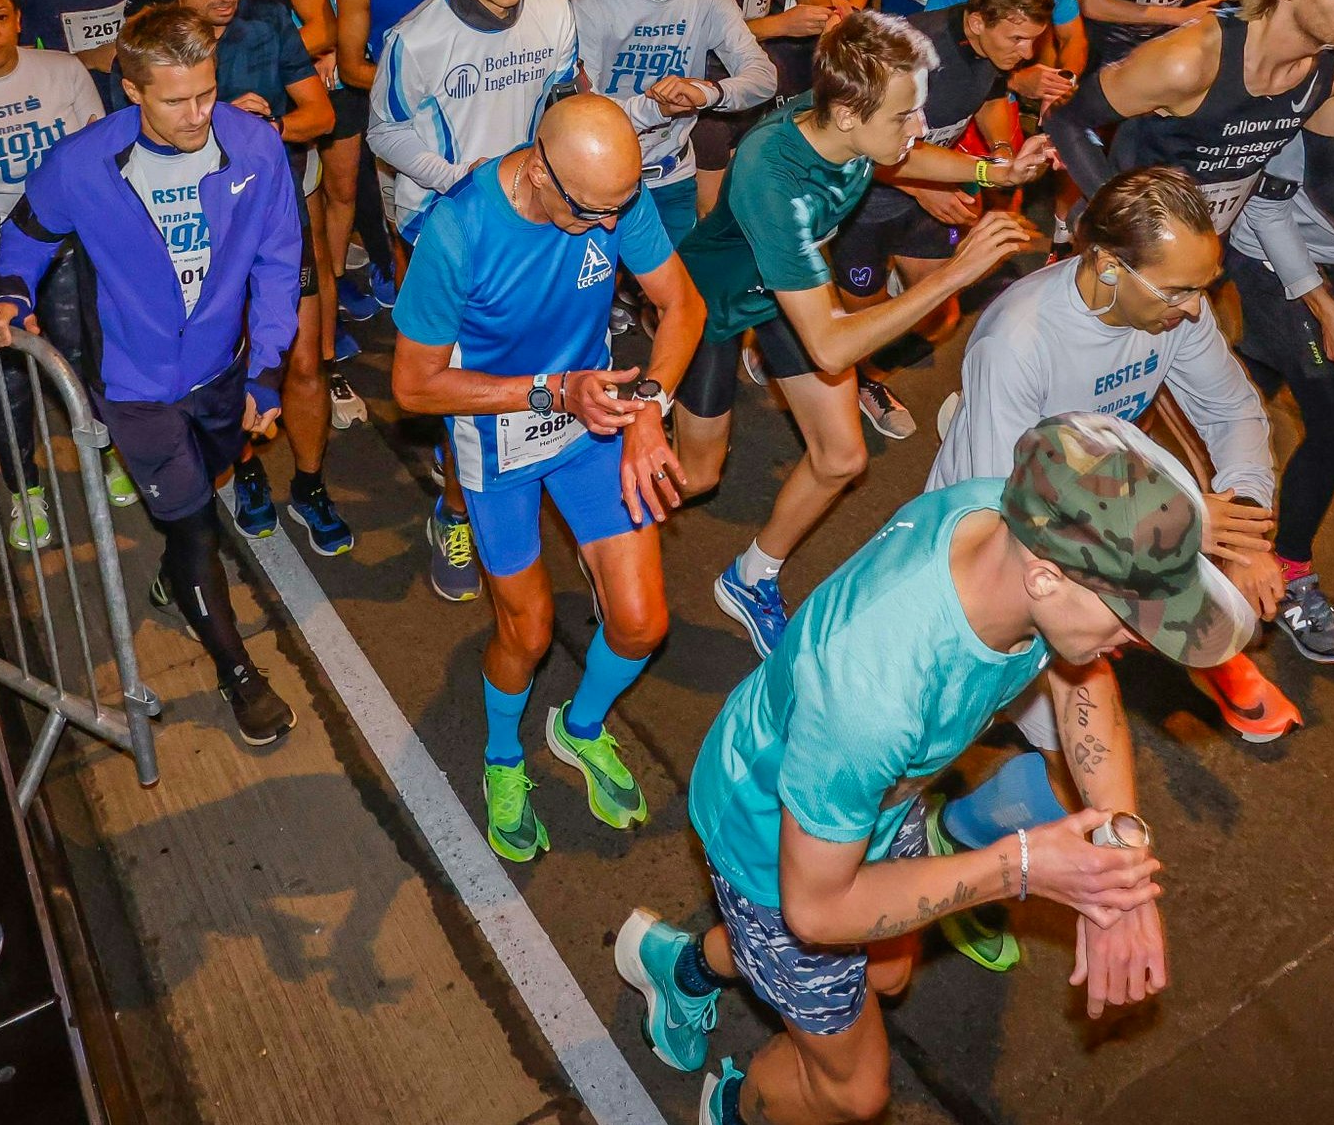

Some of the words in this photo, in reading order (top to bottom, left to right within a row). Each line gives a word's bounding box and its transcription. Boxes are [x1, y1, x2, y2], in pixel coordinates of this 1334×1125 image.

[82, 20, 121, 39] 2267
[634, 24, 675, 37] ERSTE
[628, 44, 667, 53] vienna
[485, 48, 554, 73] Boehringer
[485, 66, 546, 92] Ingelheim
[1222, 119, 1272, 137] follow
[1274, 117, 1301, 130] me
[1196, 145, 1220, 155] on
[151, 185, 197, 205] RSTE
[1208, 195, 1240, 214] 317
[180, 266, 205, 285] 01
[1094, 361, 1142, 396] ERSTE
